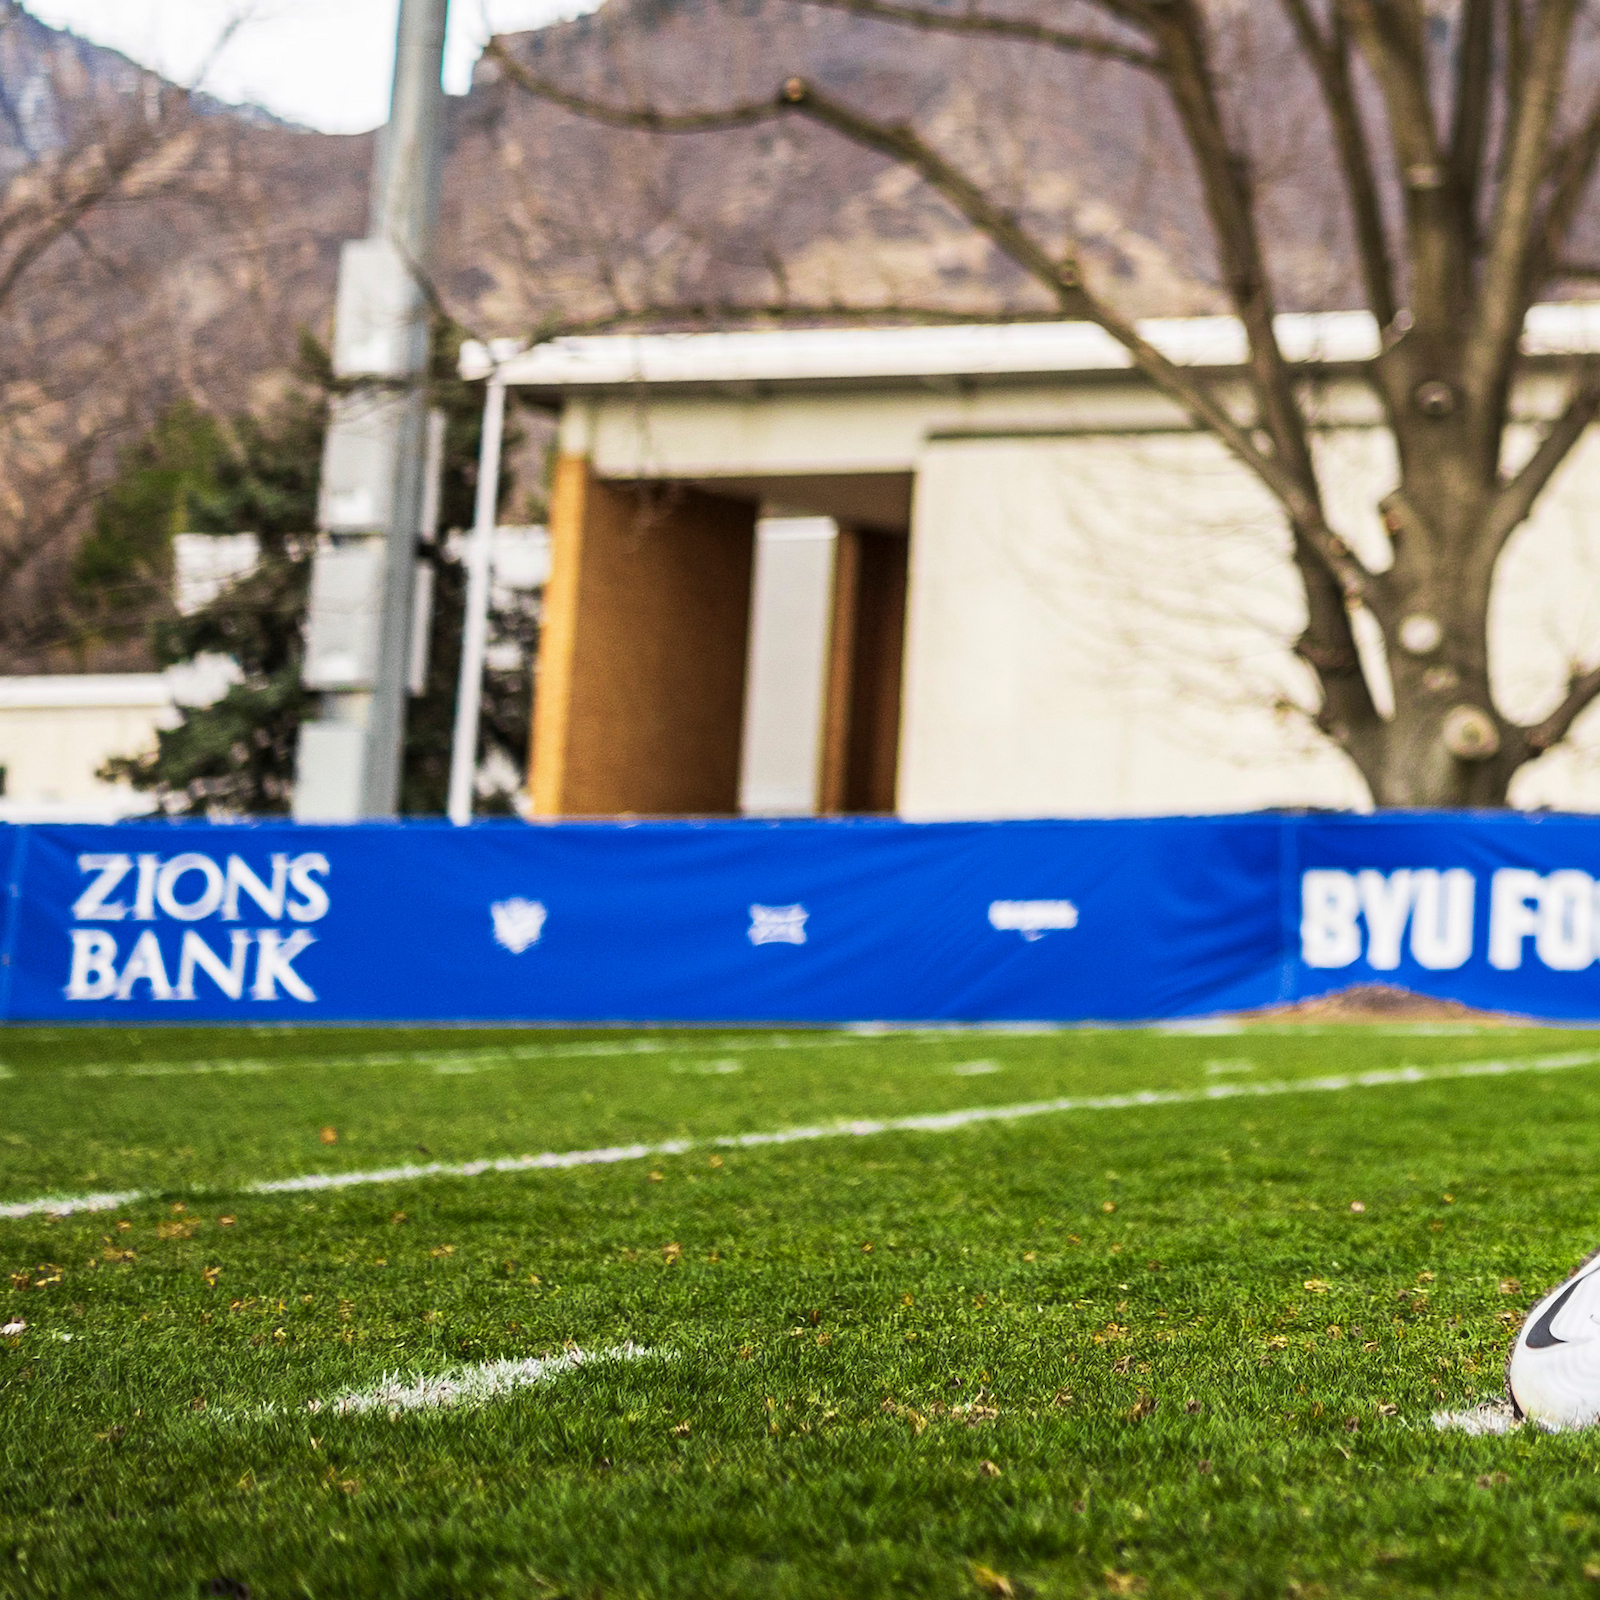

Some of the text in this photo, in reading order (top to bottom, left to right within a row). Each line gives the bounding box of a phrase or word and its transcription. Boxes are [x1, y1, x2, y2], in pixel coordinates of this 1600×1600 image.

[72, 852, 330, 922] ZIONS
[1299, 867, 1477, 971] BYU
[64, 929, 320, 1003] BANK
